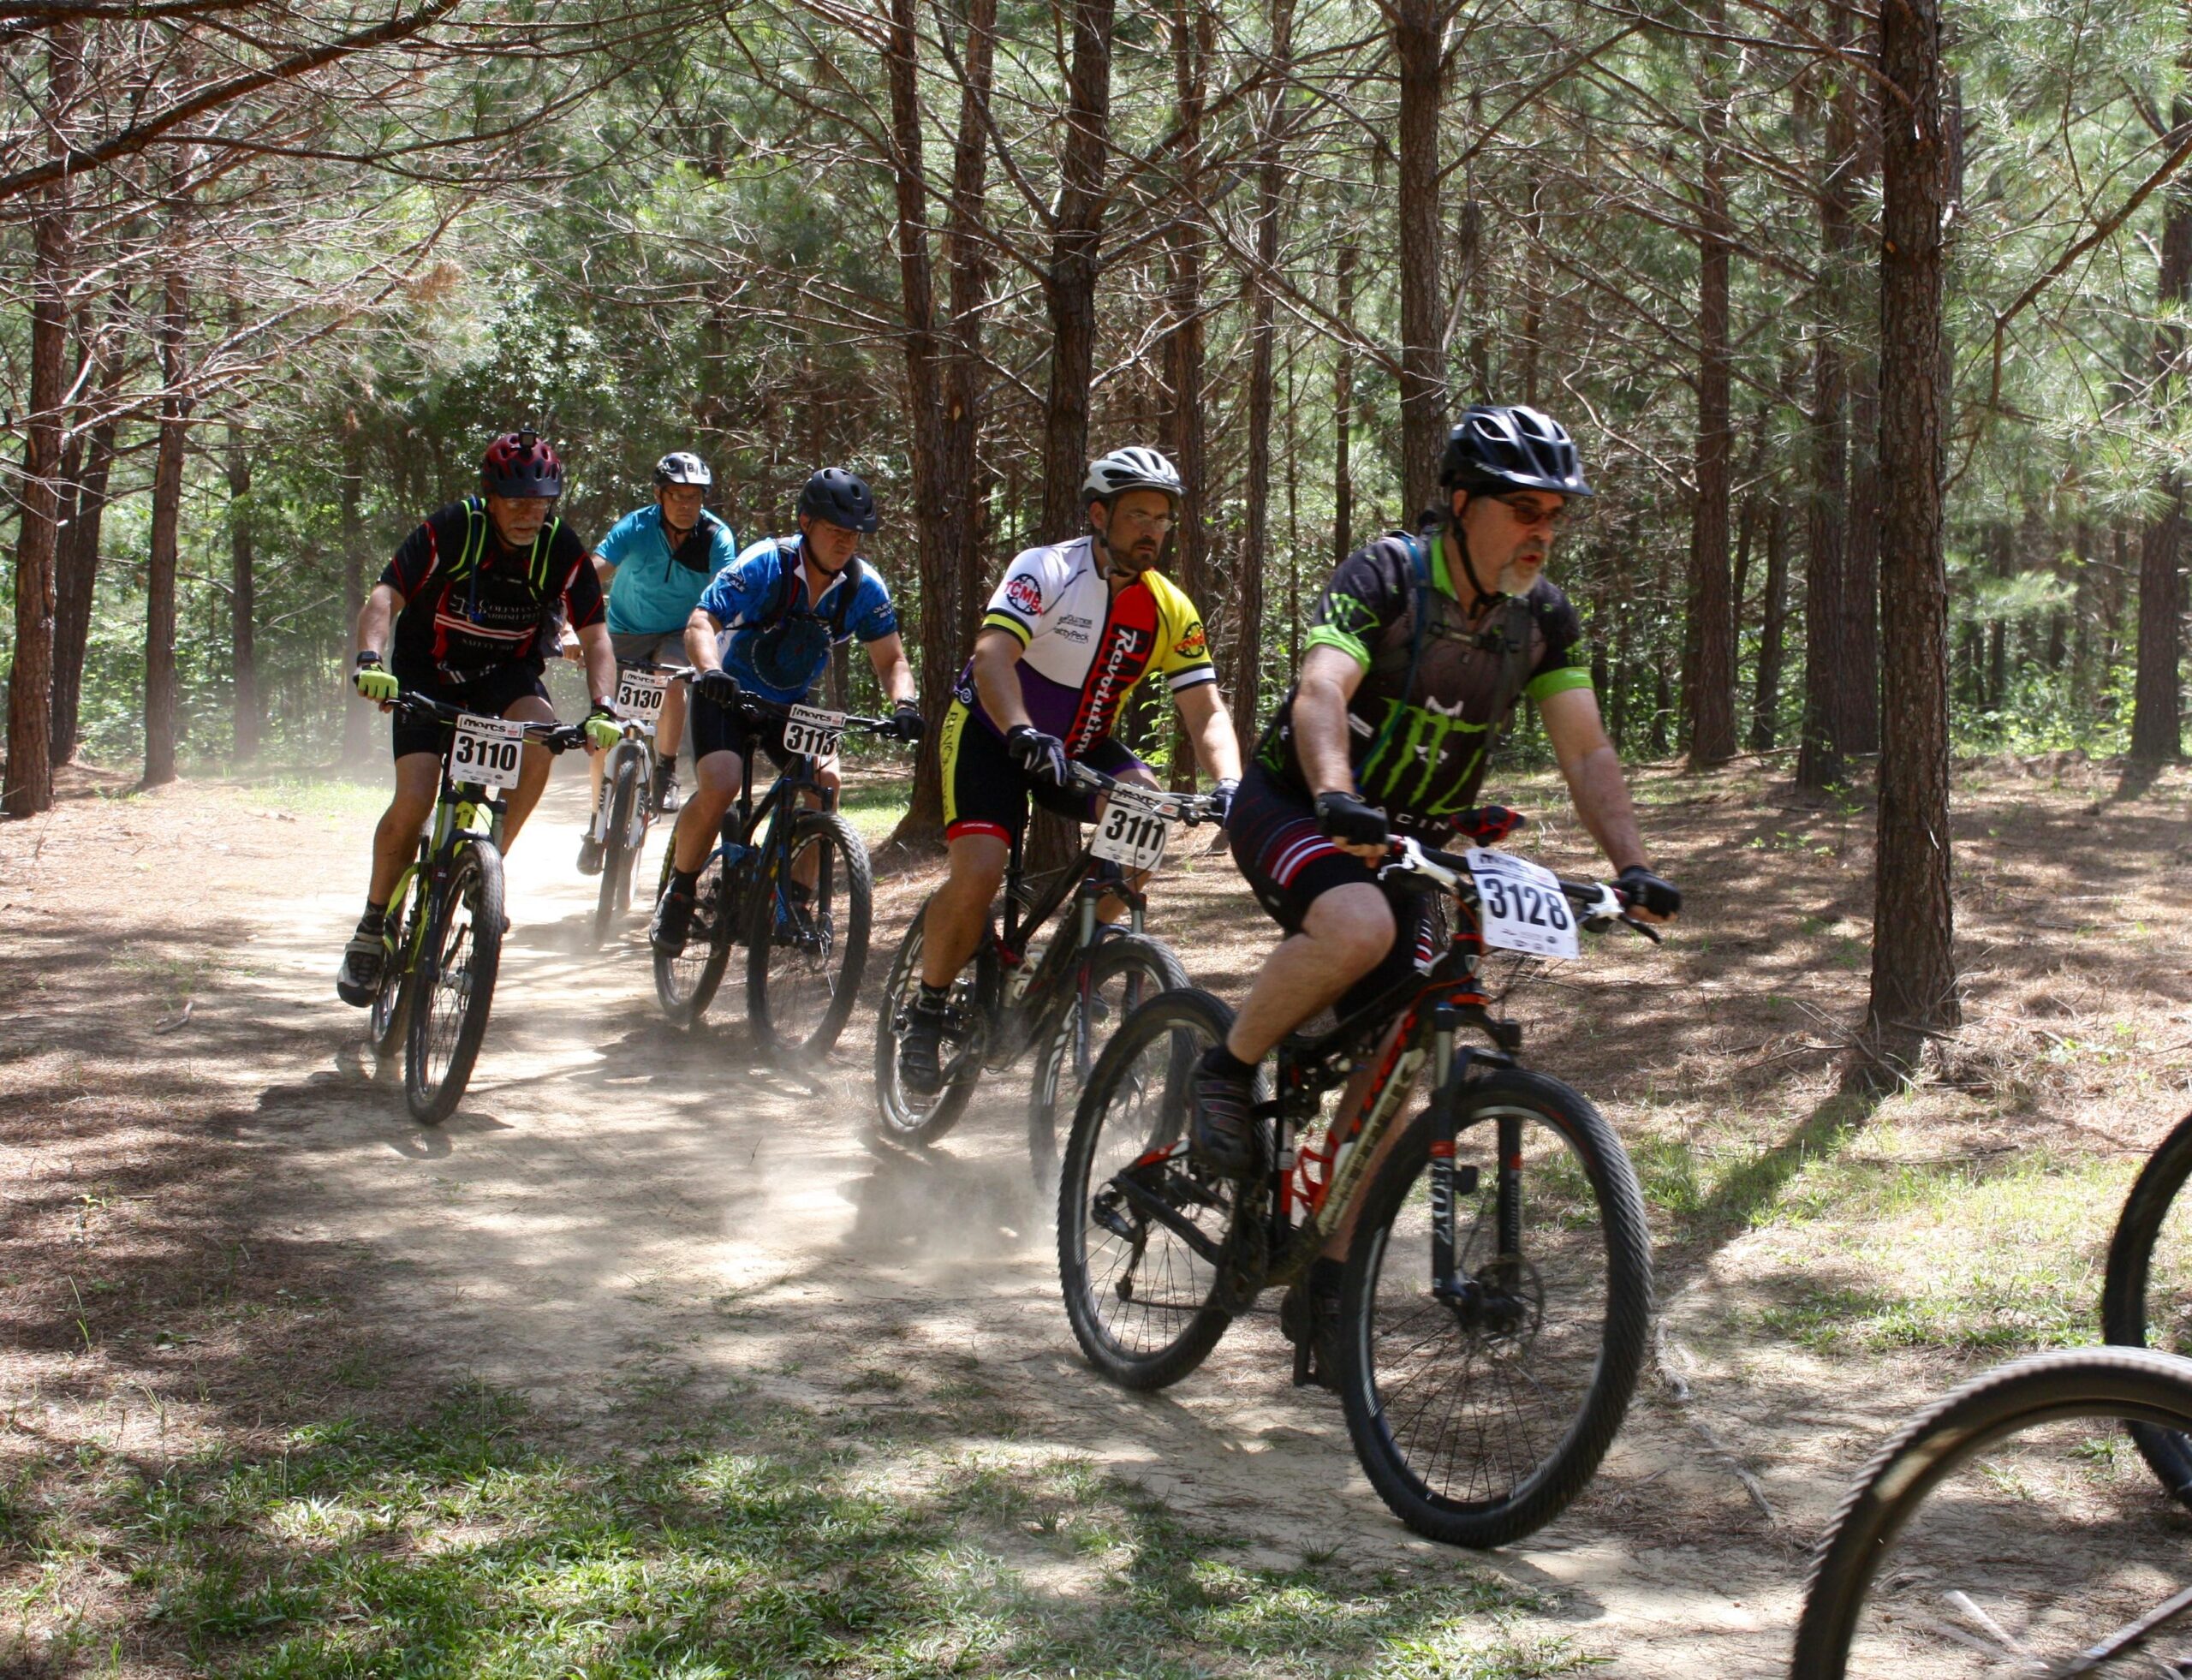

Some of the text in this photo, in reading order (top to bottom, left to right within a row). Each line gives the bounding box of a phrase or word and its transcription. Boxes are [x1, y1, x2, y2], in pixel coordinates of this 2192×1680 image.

[620, 686, 662, 709] 3130
[1073, 628, 1138, 754] Revolution
[463, 718, 506, 733] morcs
[456, 736, 517, 771] 3110
[1105, 809, 1166, 851] 3111
[1483, 878, 1569, 931] 3128
